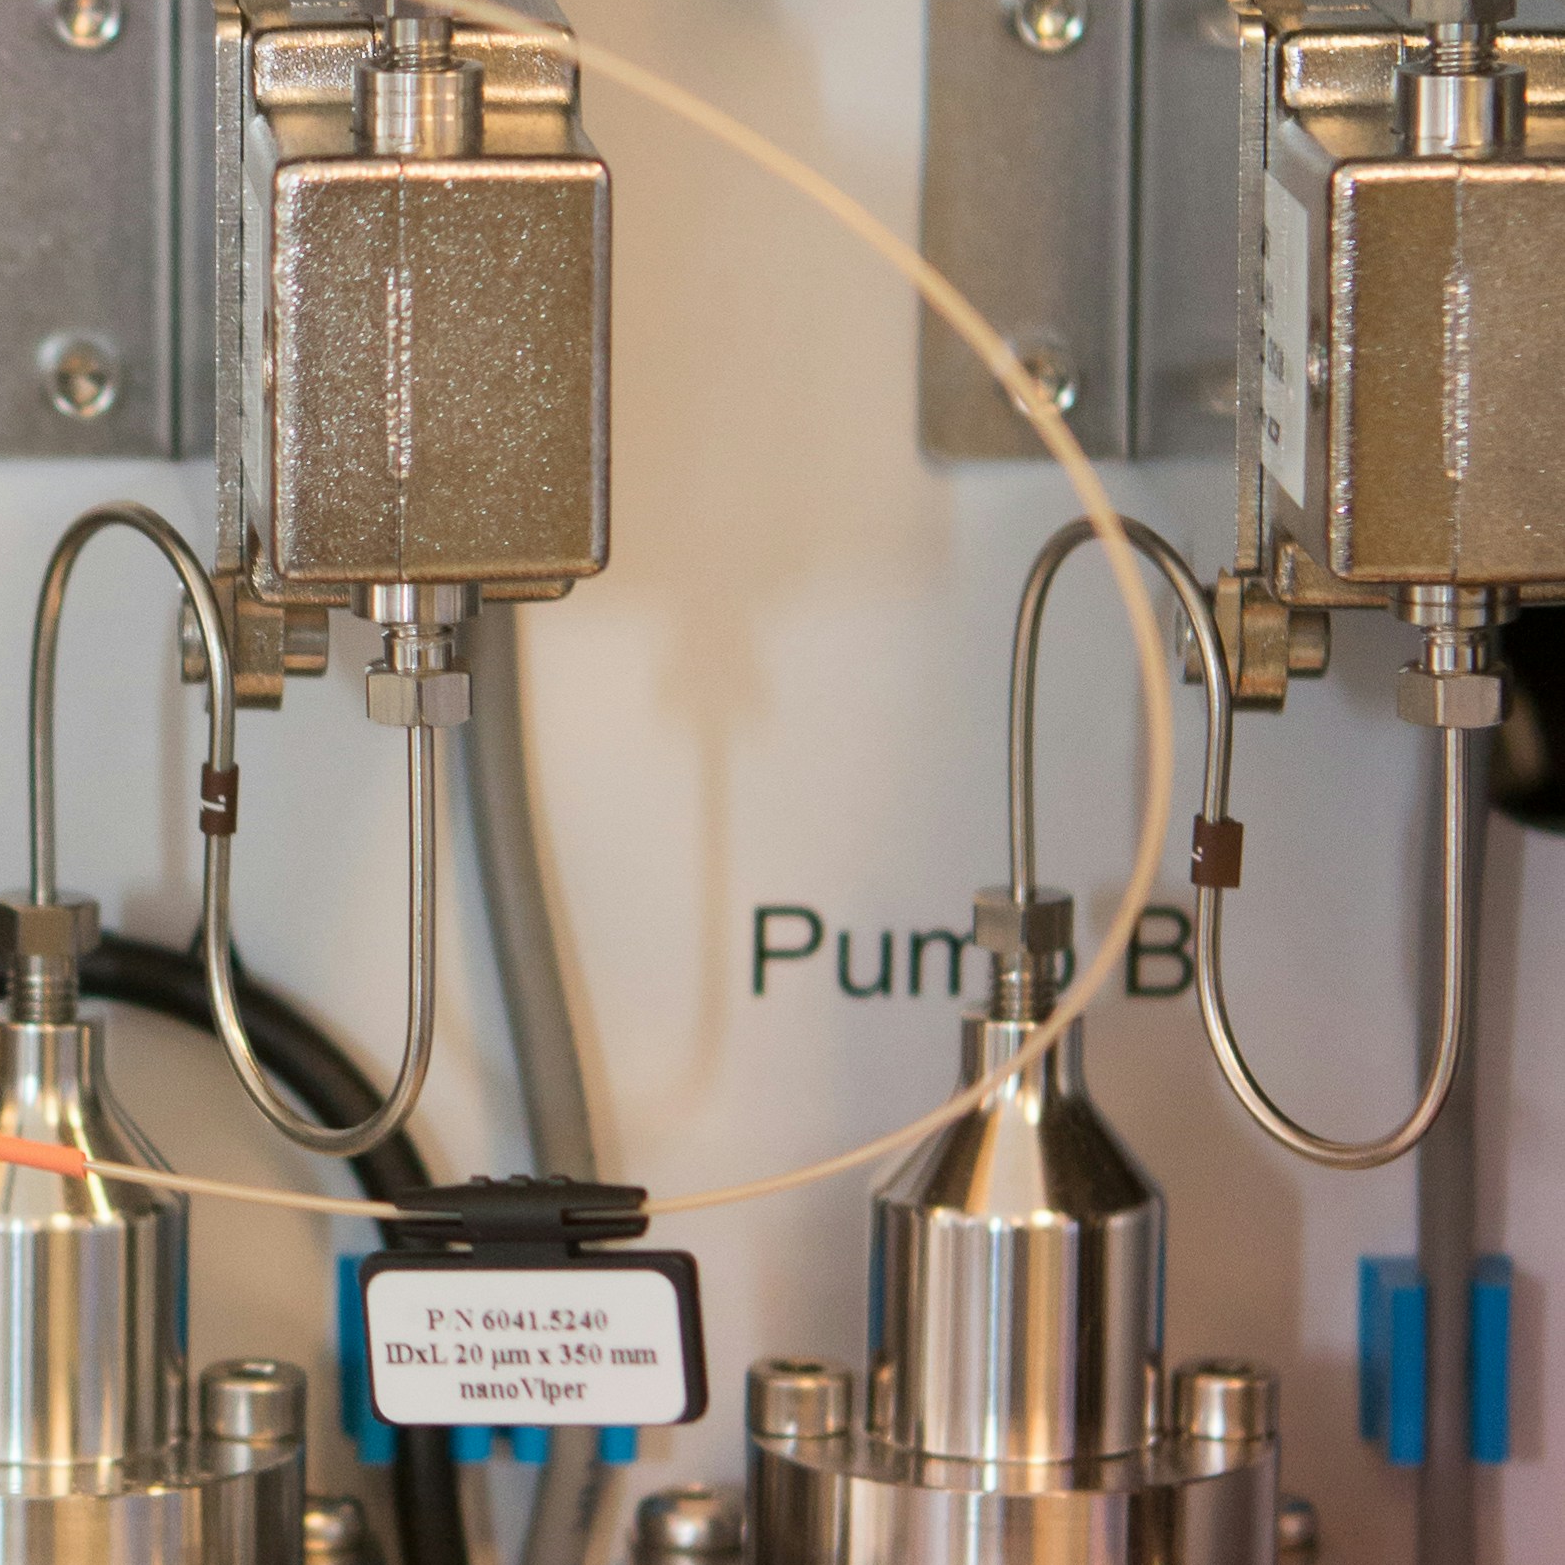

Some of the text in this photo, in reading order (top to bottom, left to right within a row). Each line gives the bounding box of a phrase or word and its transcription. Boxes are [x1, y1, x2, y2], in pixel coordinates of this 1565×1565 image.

[751, 902, 1196, 1000] Pum B
[481, 1307, 609, 1332] 6041.5240
[385, 1343, 448, 1366] IDxL
[455, 1343, 484, 1366] 20
[537, 1348, 552, 1365] x
[559, 1342, 604, 1366] 350
[609, 1346, 659, 1366] mm
